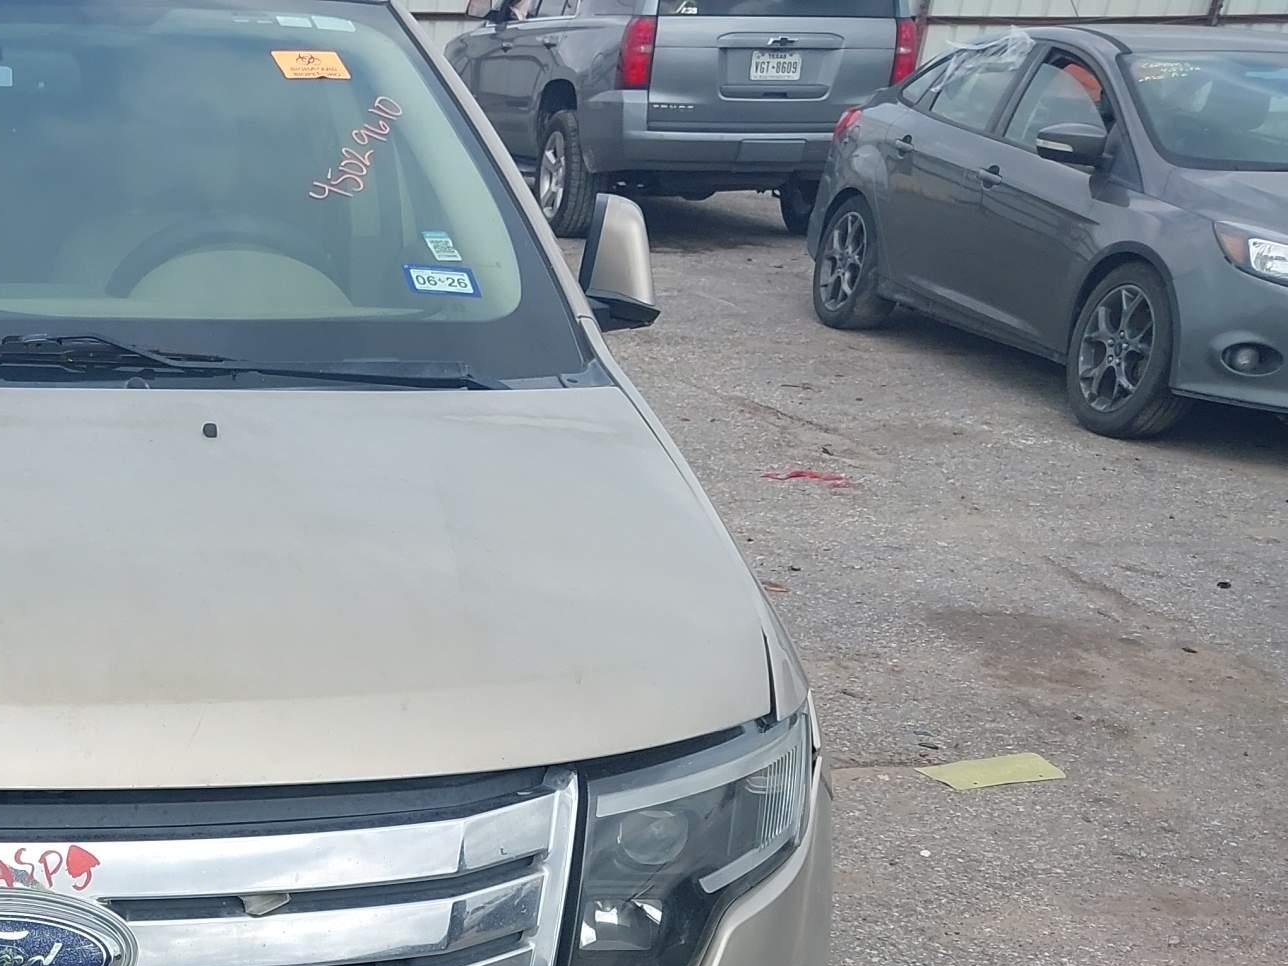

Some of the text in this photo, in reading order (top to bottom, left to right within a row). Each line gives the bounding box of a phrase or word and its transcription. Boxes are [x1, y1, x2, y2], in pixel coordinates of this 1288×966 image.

[309, 96, 402, 199] 45029610
[415, 274, 468, 289] 06 26
